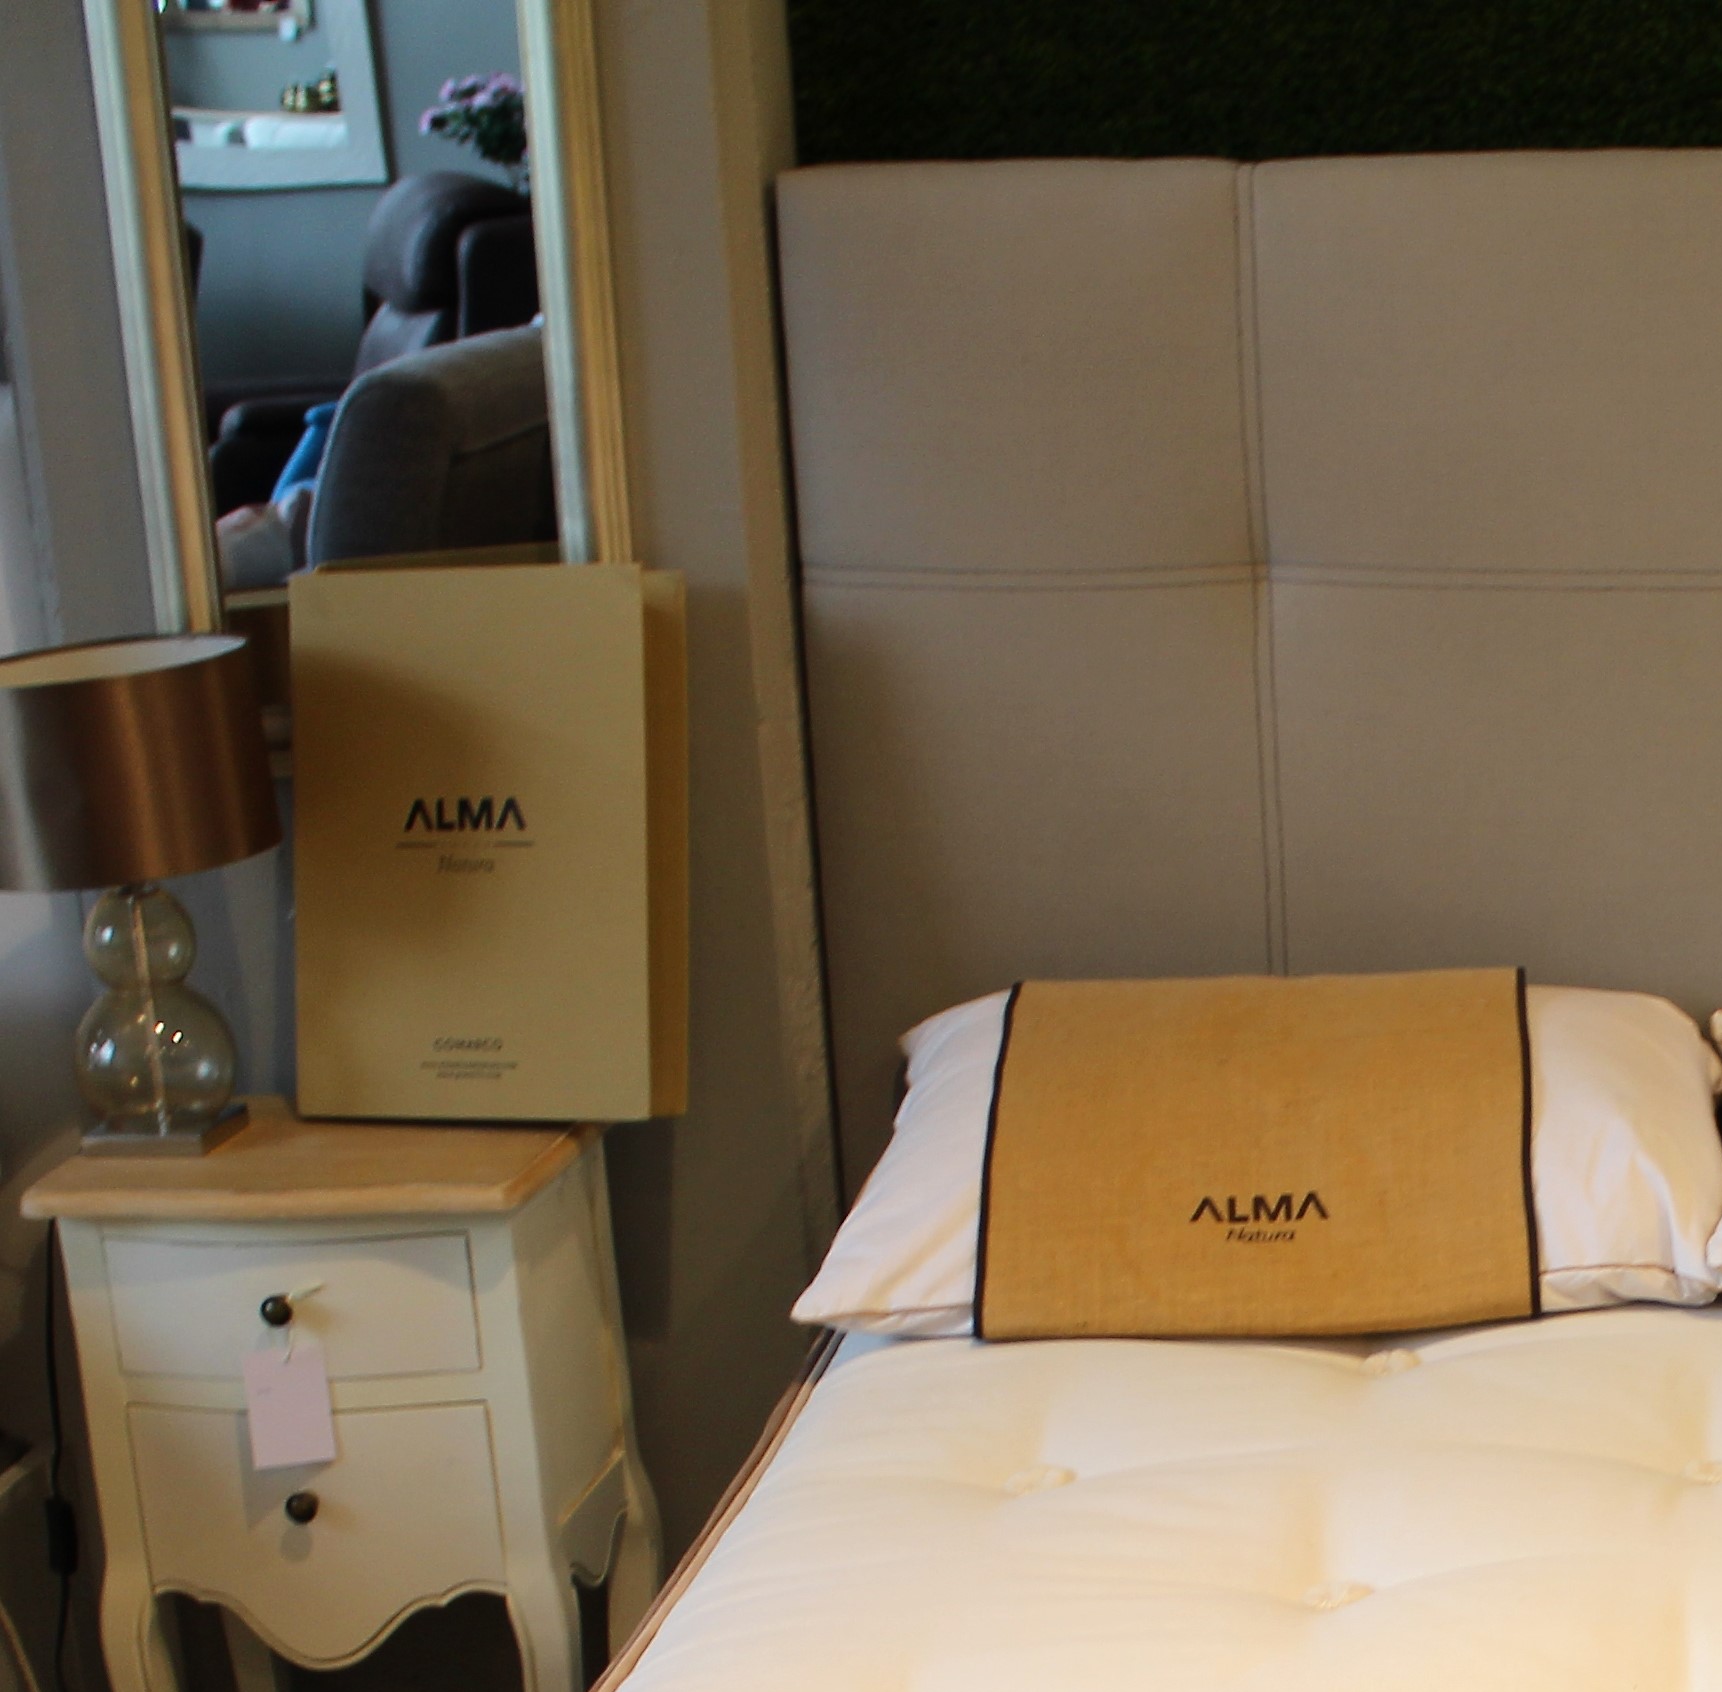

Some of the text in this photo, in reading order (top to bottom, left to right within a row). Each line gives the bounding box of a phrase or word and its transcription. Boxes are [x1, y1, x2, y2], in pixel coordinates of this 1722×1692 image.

[403, 796, 527, 832] ALMA
[1189, 1190, 1330, 1223] ALMA
[1226, 1227, 1297, 1242] Natura
